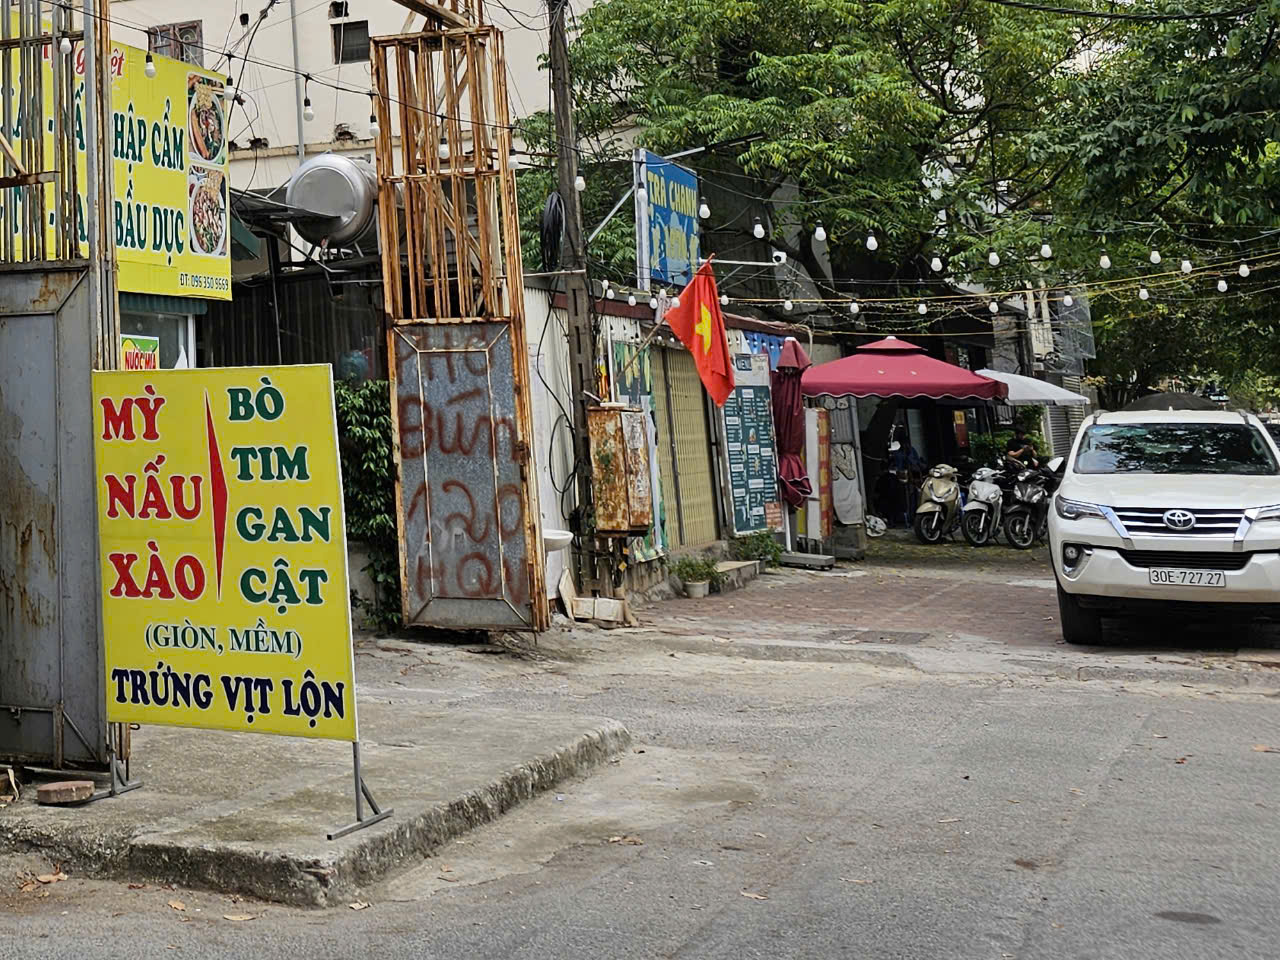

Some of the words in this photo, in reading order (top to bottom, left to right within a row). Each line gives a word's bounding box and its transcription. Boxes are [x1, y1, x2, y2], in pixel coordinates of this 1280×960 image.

[114, 102, 147, 173] HẬP
[152, 98, 184, 171] CẨM
[646, 168, 667, 208] TRÀ
[669, 180, 697, 218] CHANH
[153, 207, 184, 265] DỤC
[101, 385, 165, 440] MỲ
[228, 377, 284, 421] BÒ
[105, 455, 202, 520] NẤU
[231, 446, 310, 481] TIM
[236, 507, 331, 542] GAN
[109, 541, 206, 601] XÀO
[240, 558, 328, 614] CẬT
[1151, 570, 1222, 585] 30E-727.27
[146, 619, 224, 654] (GIÒN,
[229, 618, 302, 658] MỀM)
[112, 661, 213, 710] TRỨNG
[221, 675, 273, 723] VỊT
[282, 669, 344, 728] LỘN
